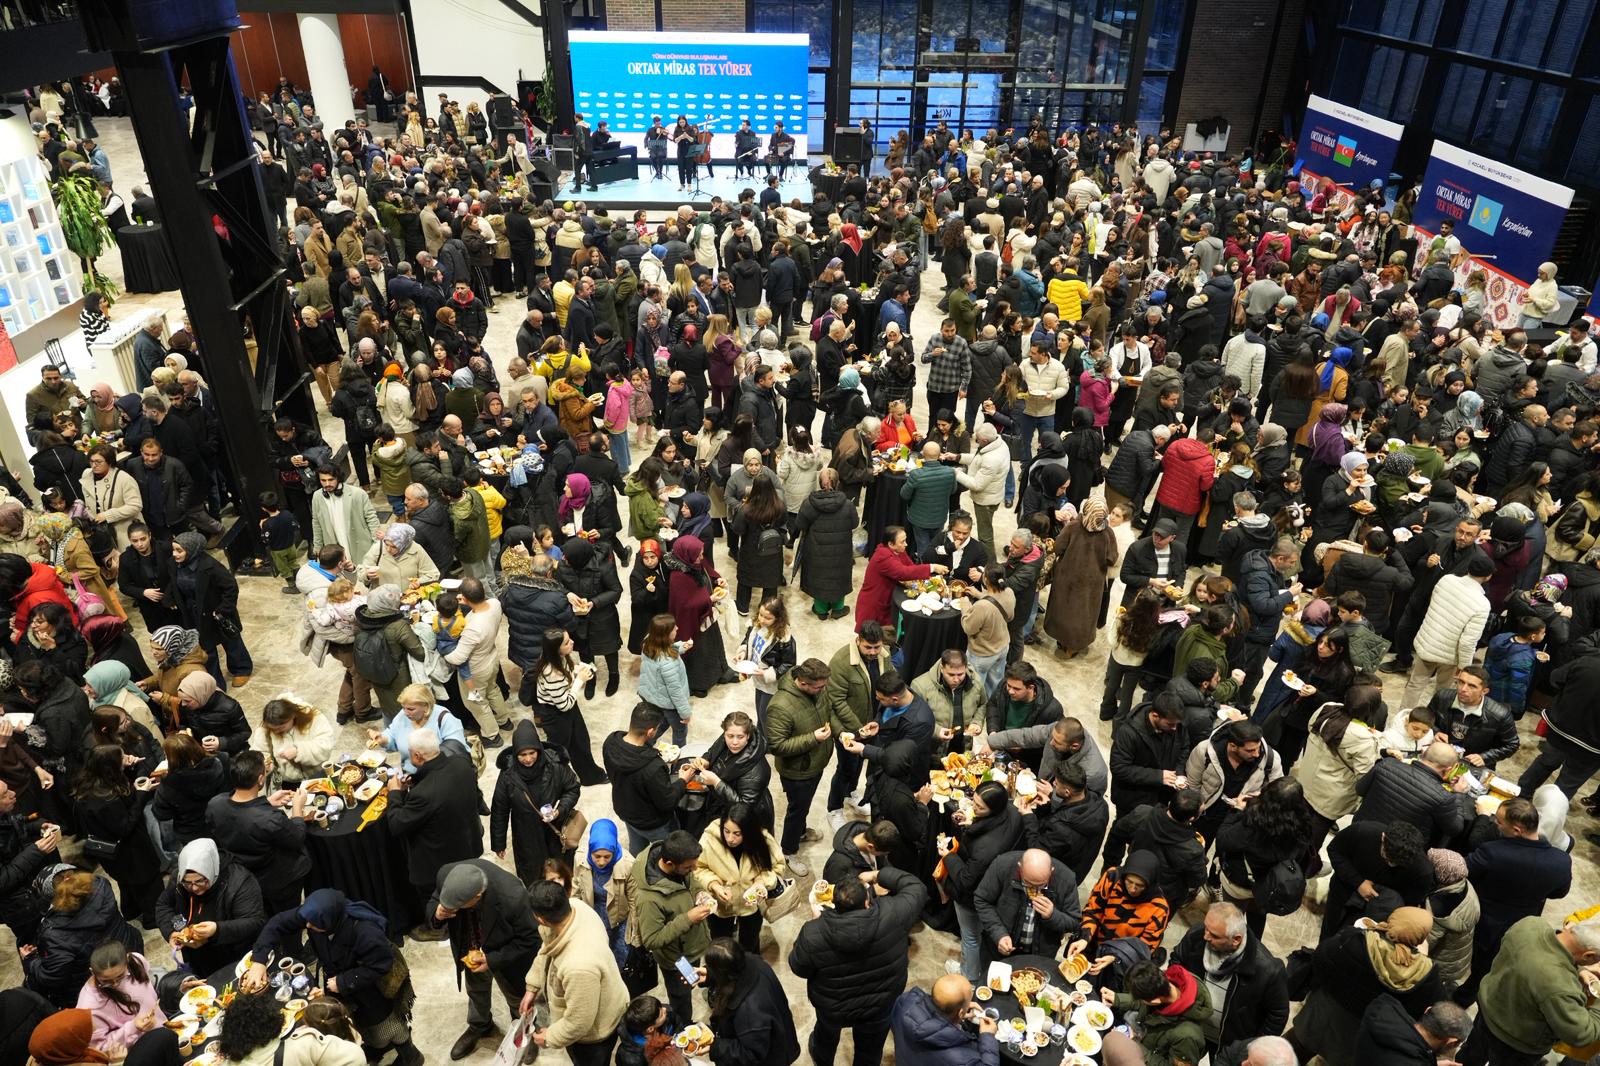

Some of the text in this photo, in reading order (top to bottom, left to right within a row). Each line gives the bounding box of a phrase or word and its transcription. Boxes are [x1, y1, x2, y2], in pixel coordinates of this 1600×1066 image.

[627, 60, 752, 76] ORTAK MİRAS TEK YÜREK
[1310, 130, 1323, 143] ORTAK
[1323, 135, 1336, 148] MİRAS
[1436, 185, 1454, 200] ORTAK
[1452, 192, 1472, 210] MİRAS
[1436, 199, 1463, 220] TEK YÜREK
